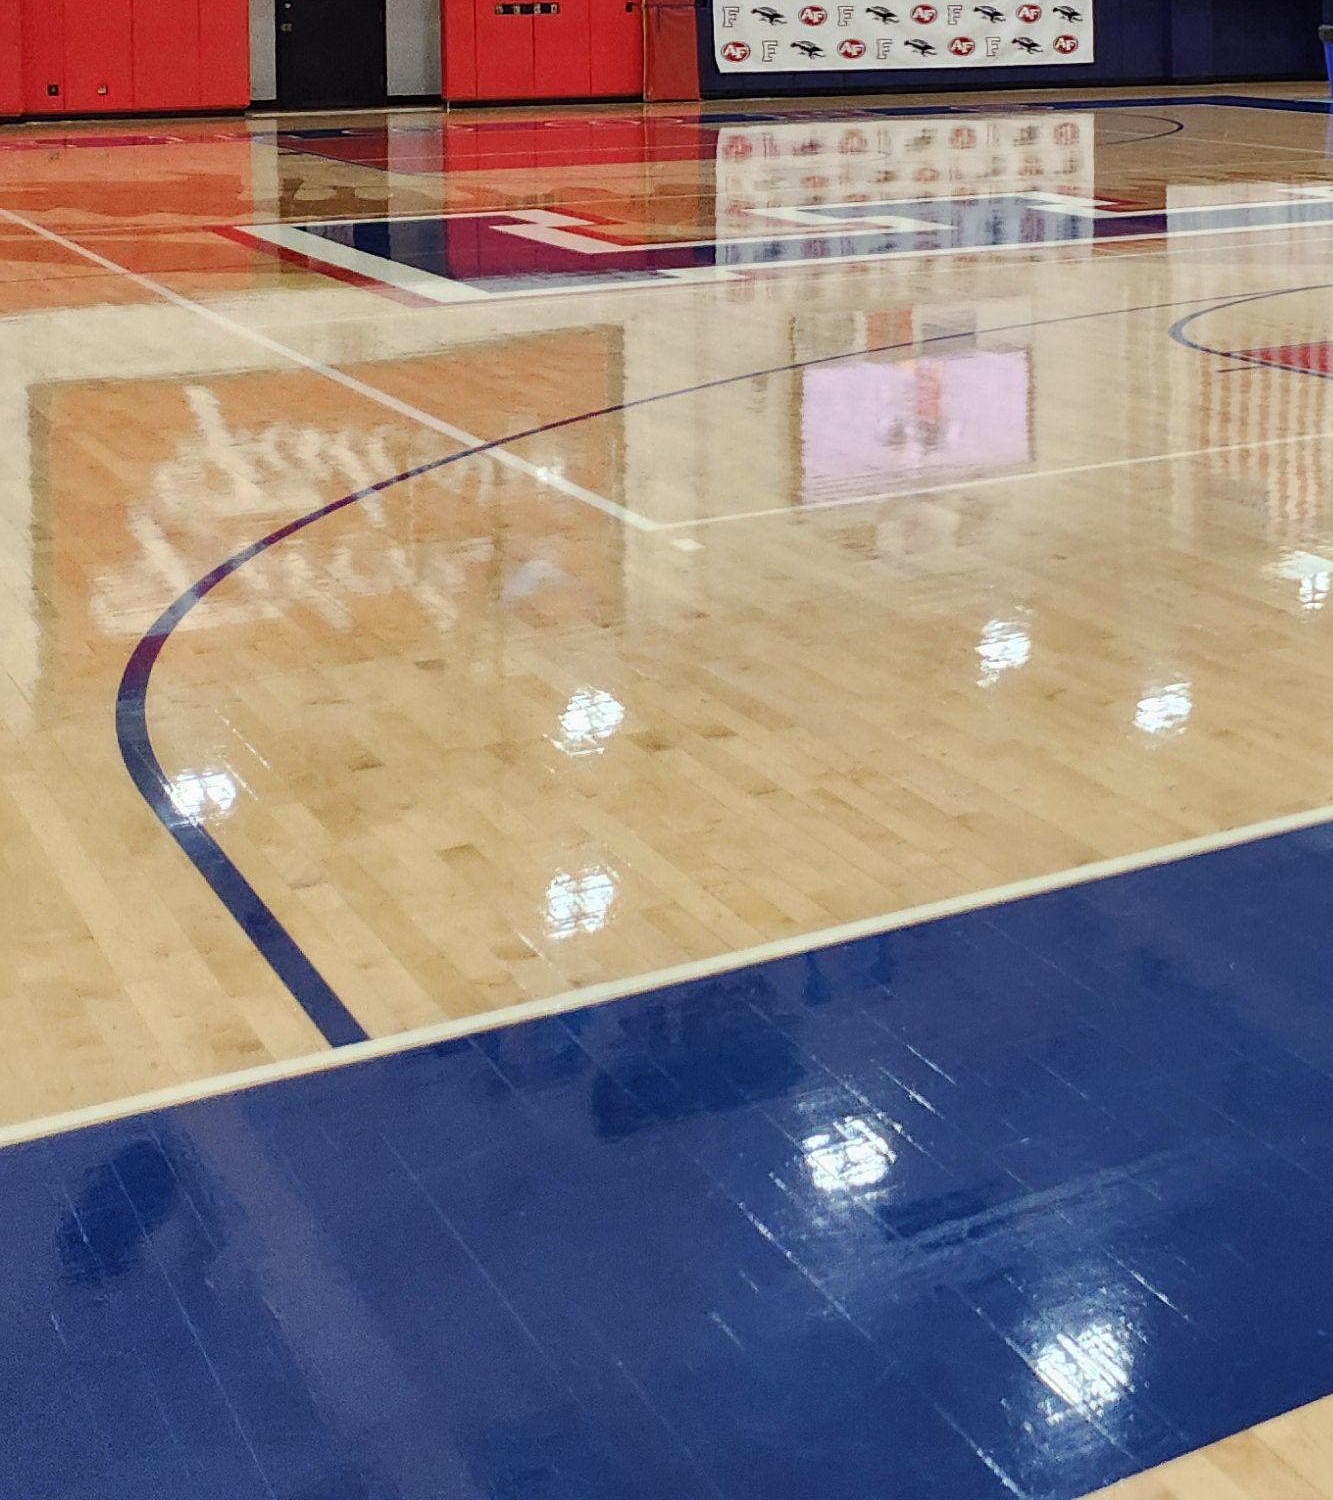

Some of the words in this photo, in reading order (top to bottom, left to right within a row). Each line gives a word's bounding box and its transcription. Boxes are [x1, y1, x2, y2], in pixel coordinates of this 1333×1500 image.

[723, 6, 739, 28] F
[800, 7, 827, 24] AF
[838, 6, 854, 26] F
[911, 6, 937, 23] AF
[947, 5, 963, 25] F
[1017, 6, 1041, 21] AF
[722, 44, 750, 61] AF
[762, 40, 779, 62] F
[839, 41, 865, 57] AF
[877, 39, 893, 60] F
[950, 39, 976, 55] AF
[986, 37, 1001, 57] F
[1054, 37, 1078, 52] AF
